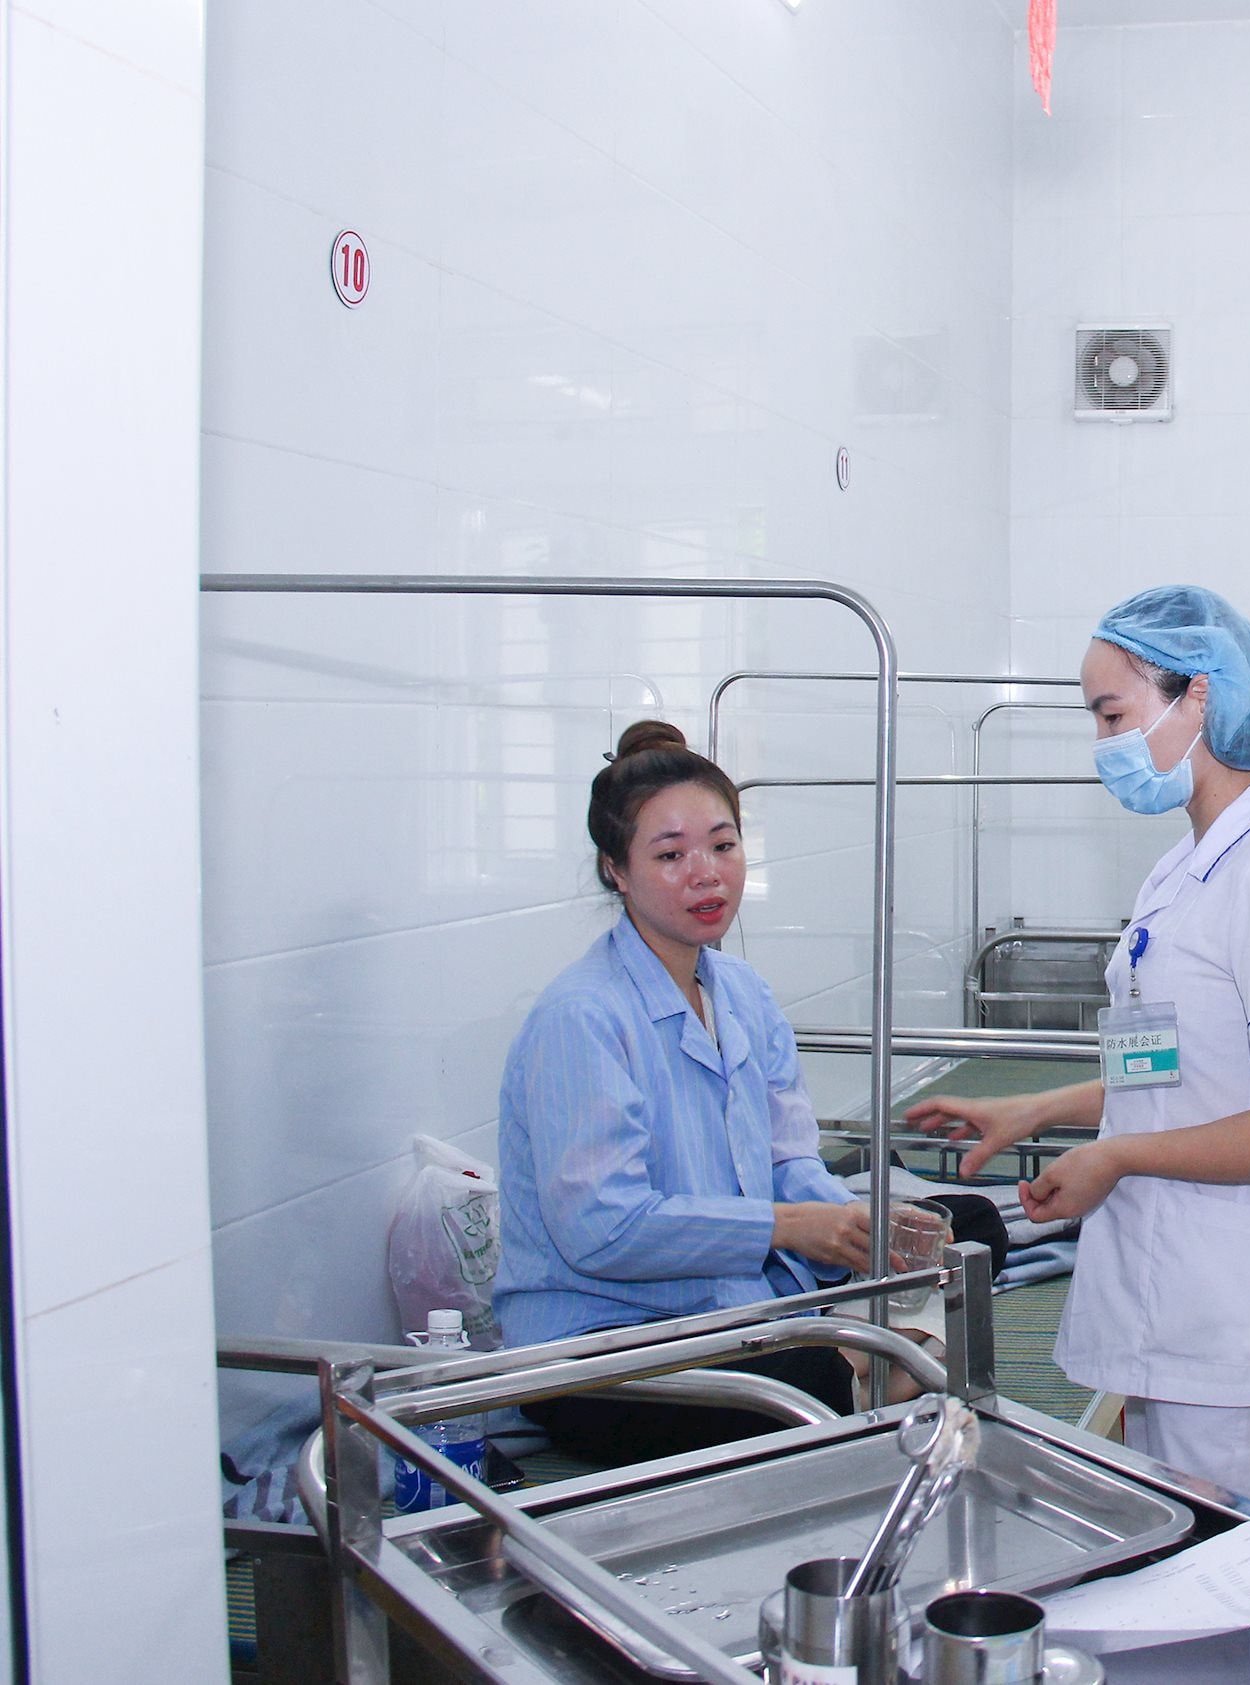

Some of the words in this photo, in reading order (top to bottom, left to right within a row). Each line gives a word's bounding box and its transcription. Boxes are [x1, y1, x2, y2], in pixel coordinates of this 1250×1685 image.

[342, 244, 364, 292] 10
[841, 455, 848, 480] 11
[1106, 1034, 1162, 1049] 防水展会证
